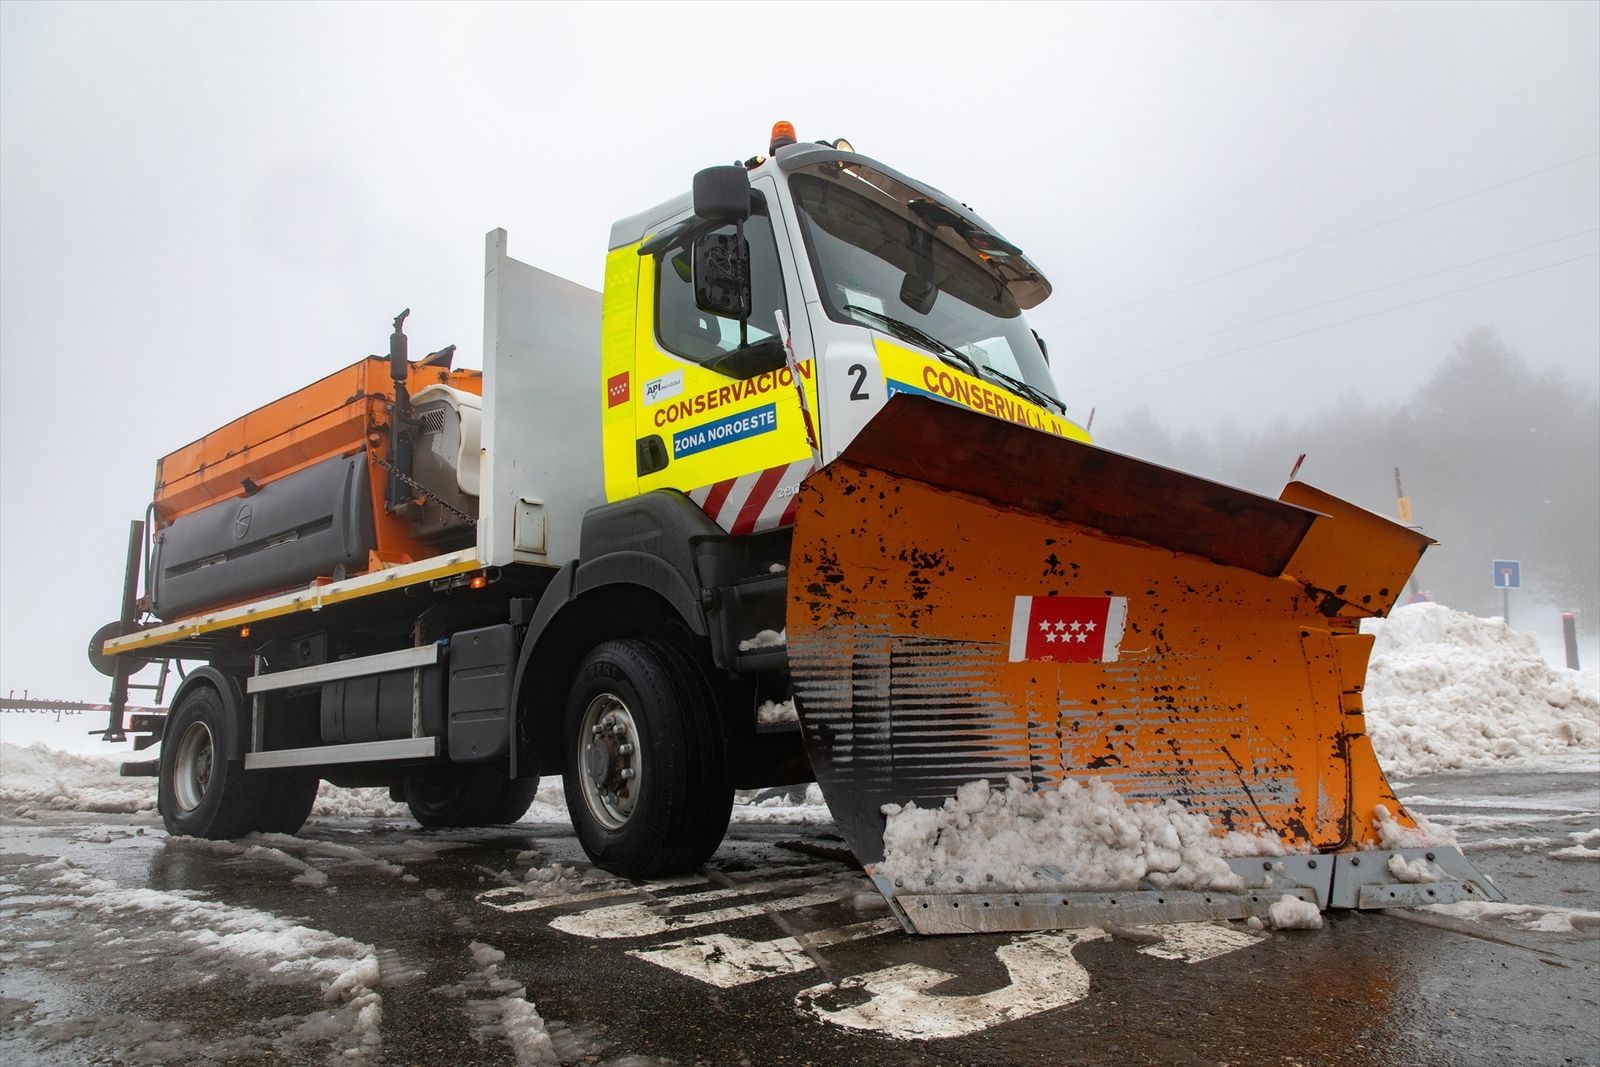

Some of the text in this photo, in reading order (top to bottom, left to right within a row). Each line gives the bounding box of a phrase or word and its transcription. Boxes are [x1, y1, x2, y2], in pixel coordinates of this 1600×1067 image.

[646, 383, 661, 396] API
[848, 364, 869, 400] 2
[675, 410, 776, 452] ZONA NOROESTE
